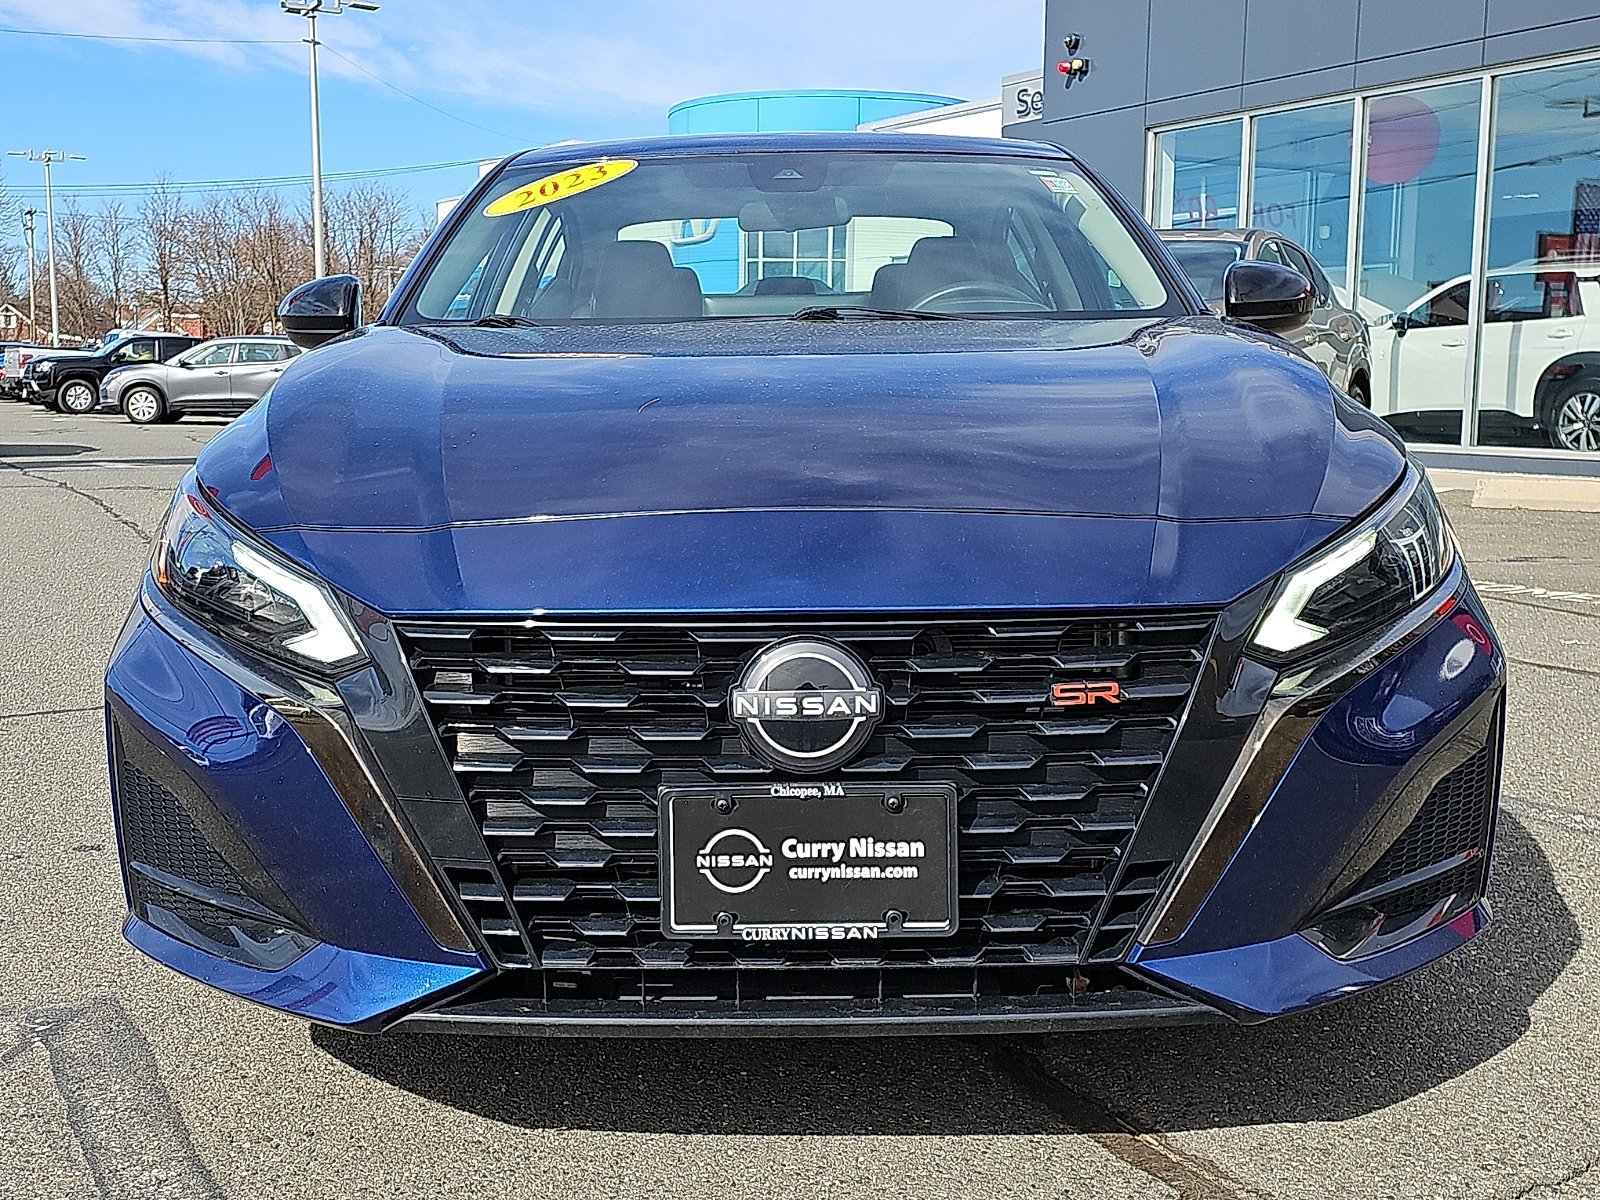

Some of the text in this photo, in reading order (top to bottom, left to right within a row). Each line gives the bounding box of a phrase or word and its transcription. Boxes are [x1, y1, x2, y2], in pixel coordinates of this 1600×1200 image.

[1016, 88, 1044, 115] Se
[515, 165, 608, 208] 2023
[736, 694, 878, 716] NISSAN
[1051, 681, 1121, 706] SR
[770, 785, 845, 799] Chicopee, MA
[696, 854, 773, 868] NISSAN
[781, 837, 925, 863] Curry Nissan
[788, 863, 919, 883] currynissan.com
